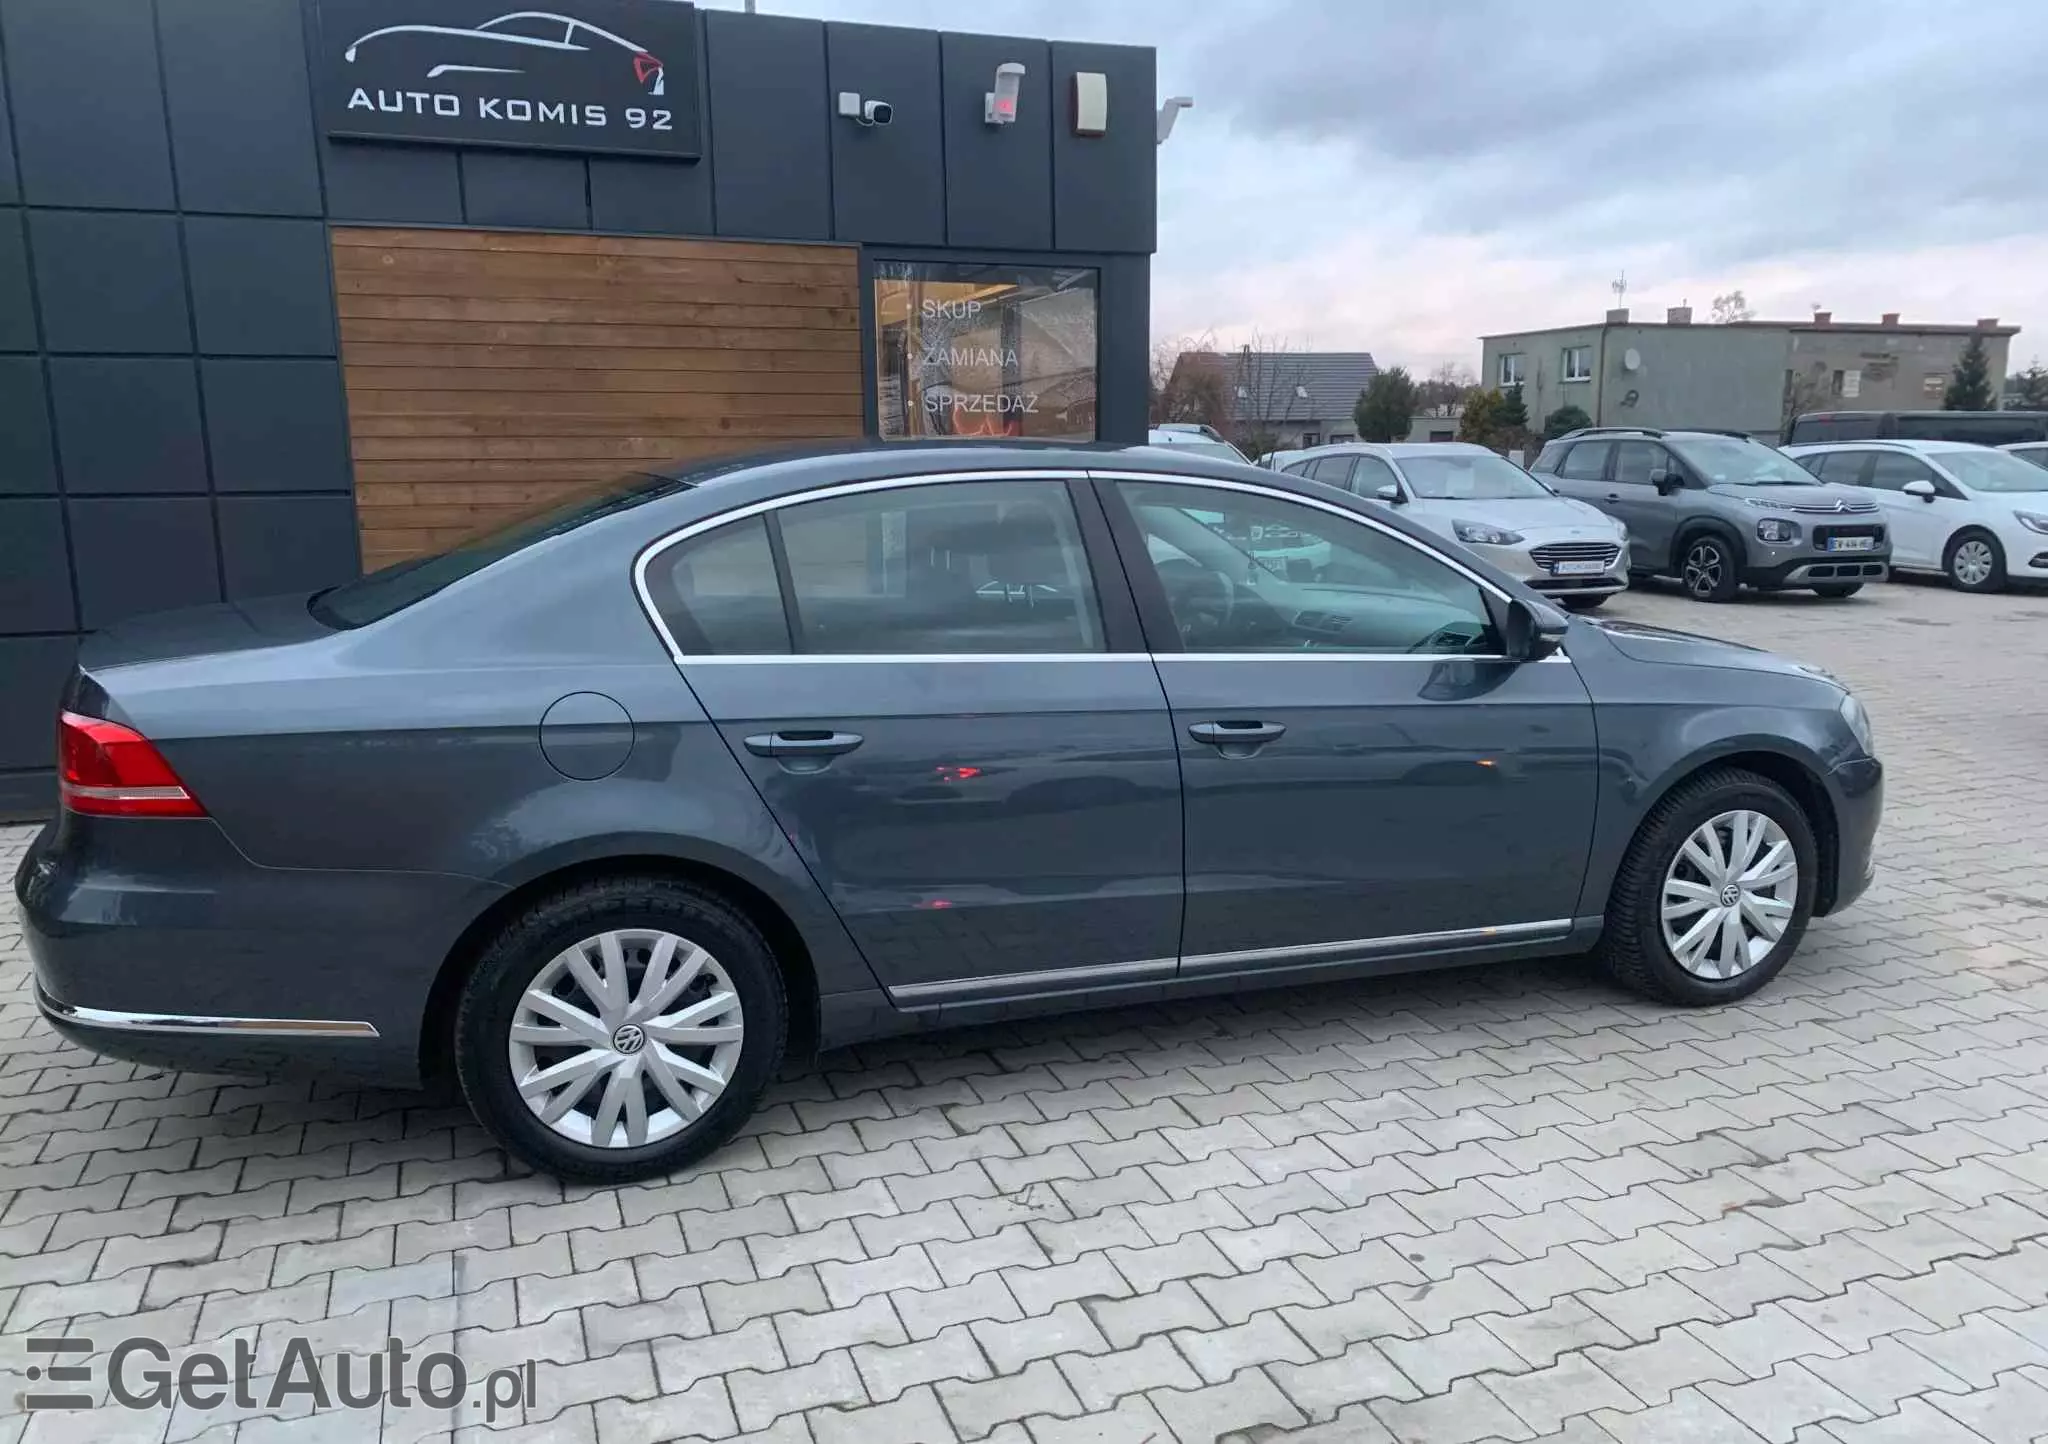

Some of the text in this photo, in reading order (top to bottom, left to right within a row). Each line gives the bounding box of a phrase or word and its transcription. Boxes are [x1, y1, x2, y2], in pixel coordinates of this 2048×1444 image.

[347, 87, 673, 130] AUTO KOMIS 92
[921, 300, 982, 320] SKUP
[922, 348, 1019, 367] ZAMIANA
